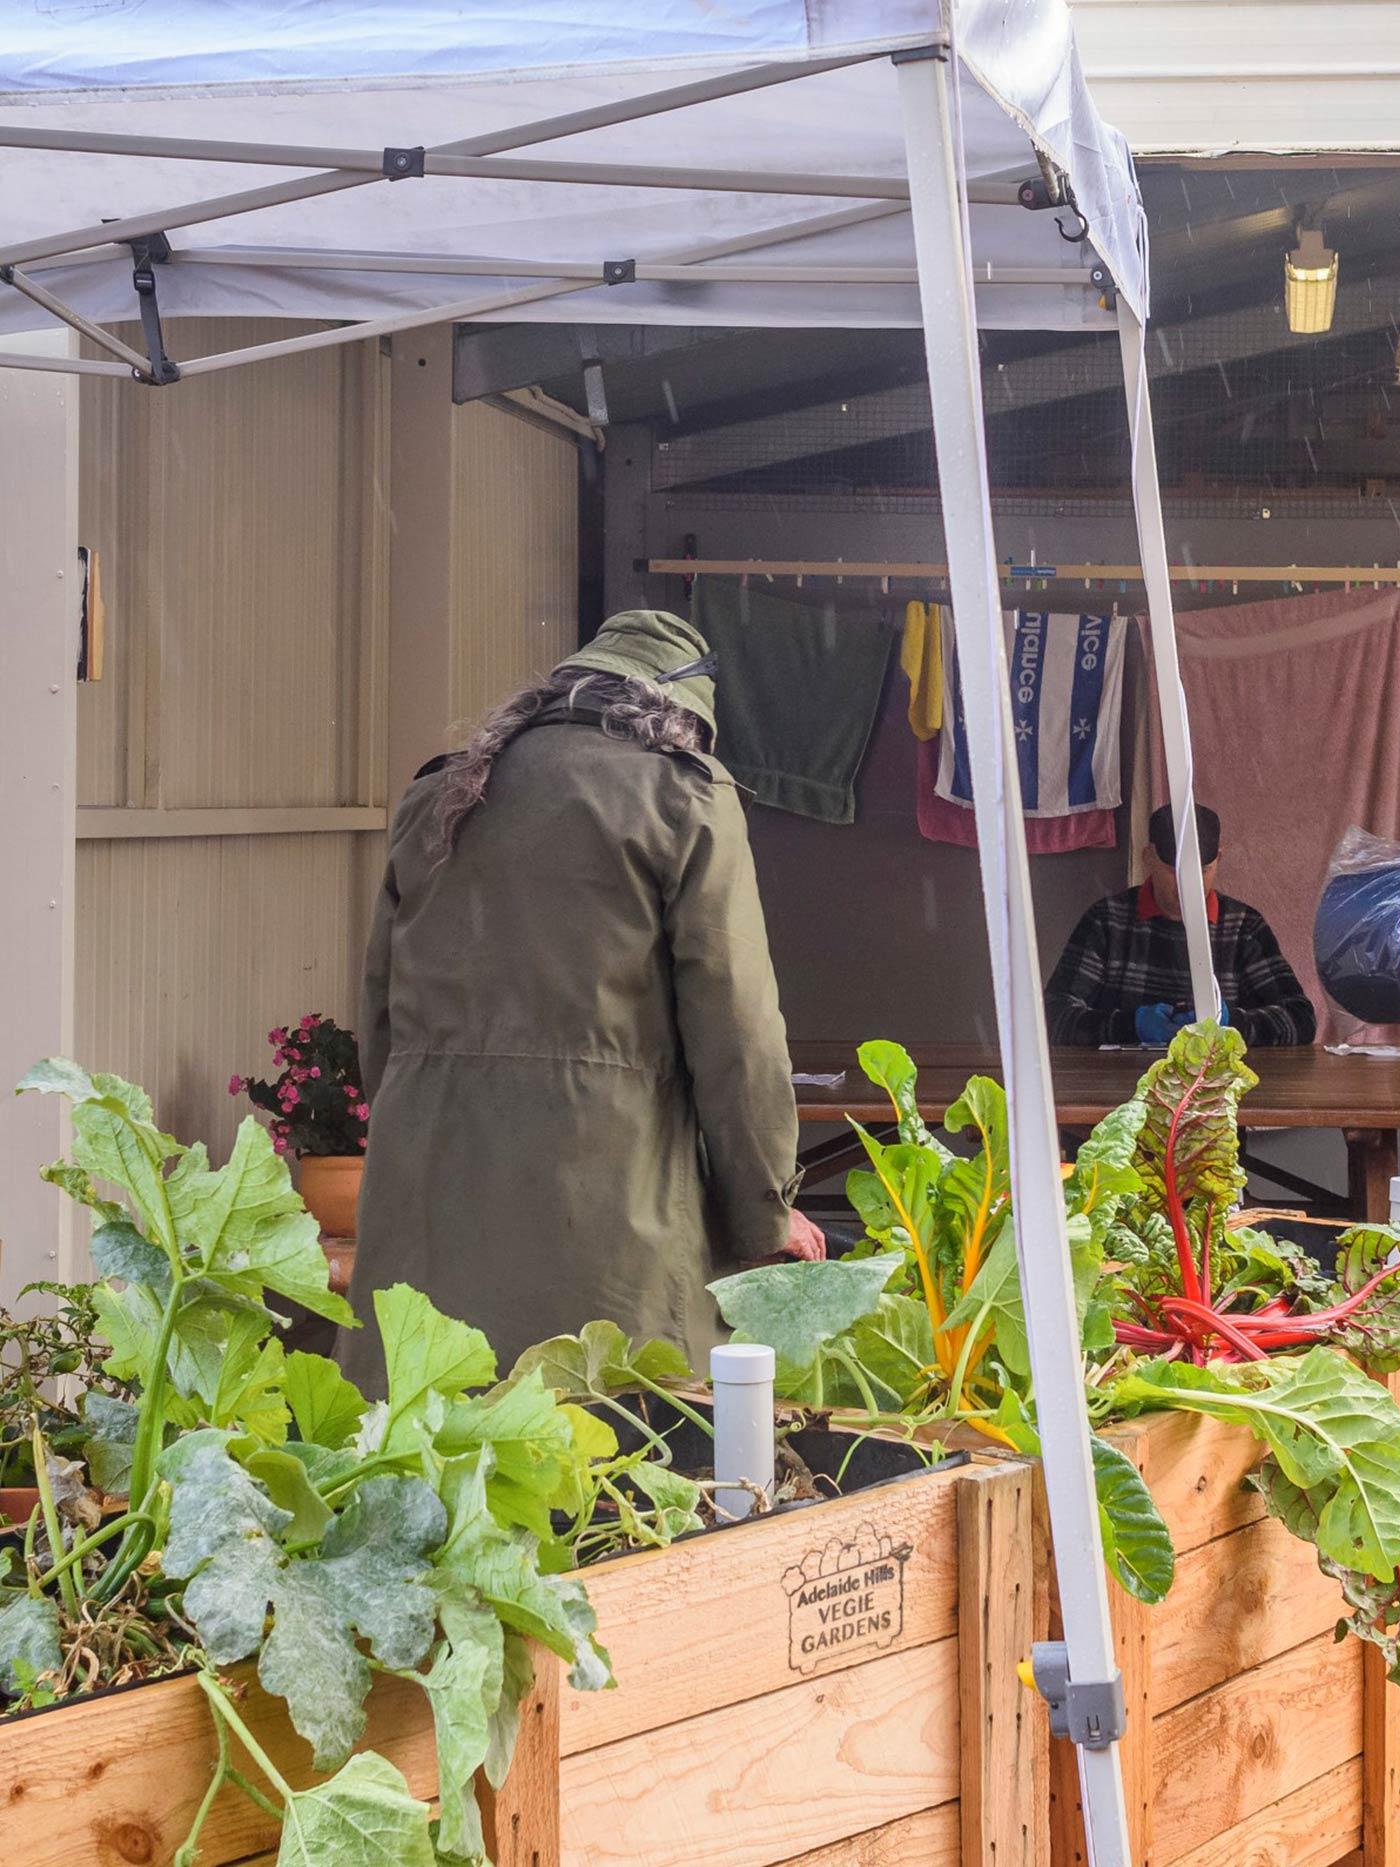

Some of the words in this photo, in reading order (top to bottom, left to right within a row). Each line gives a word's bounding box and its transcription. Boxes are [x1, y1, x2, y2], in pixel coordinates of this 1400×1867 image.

[796, 1578, 860, 1608] Adelaide
[863, 1563, 896, 1589] Hills
[818, 1591, 875, 1625] VEGIE
[801, 1610, 891, 1655] GARDENS
